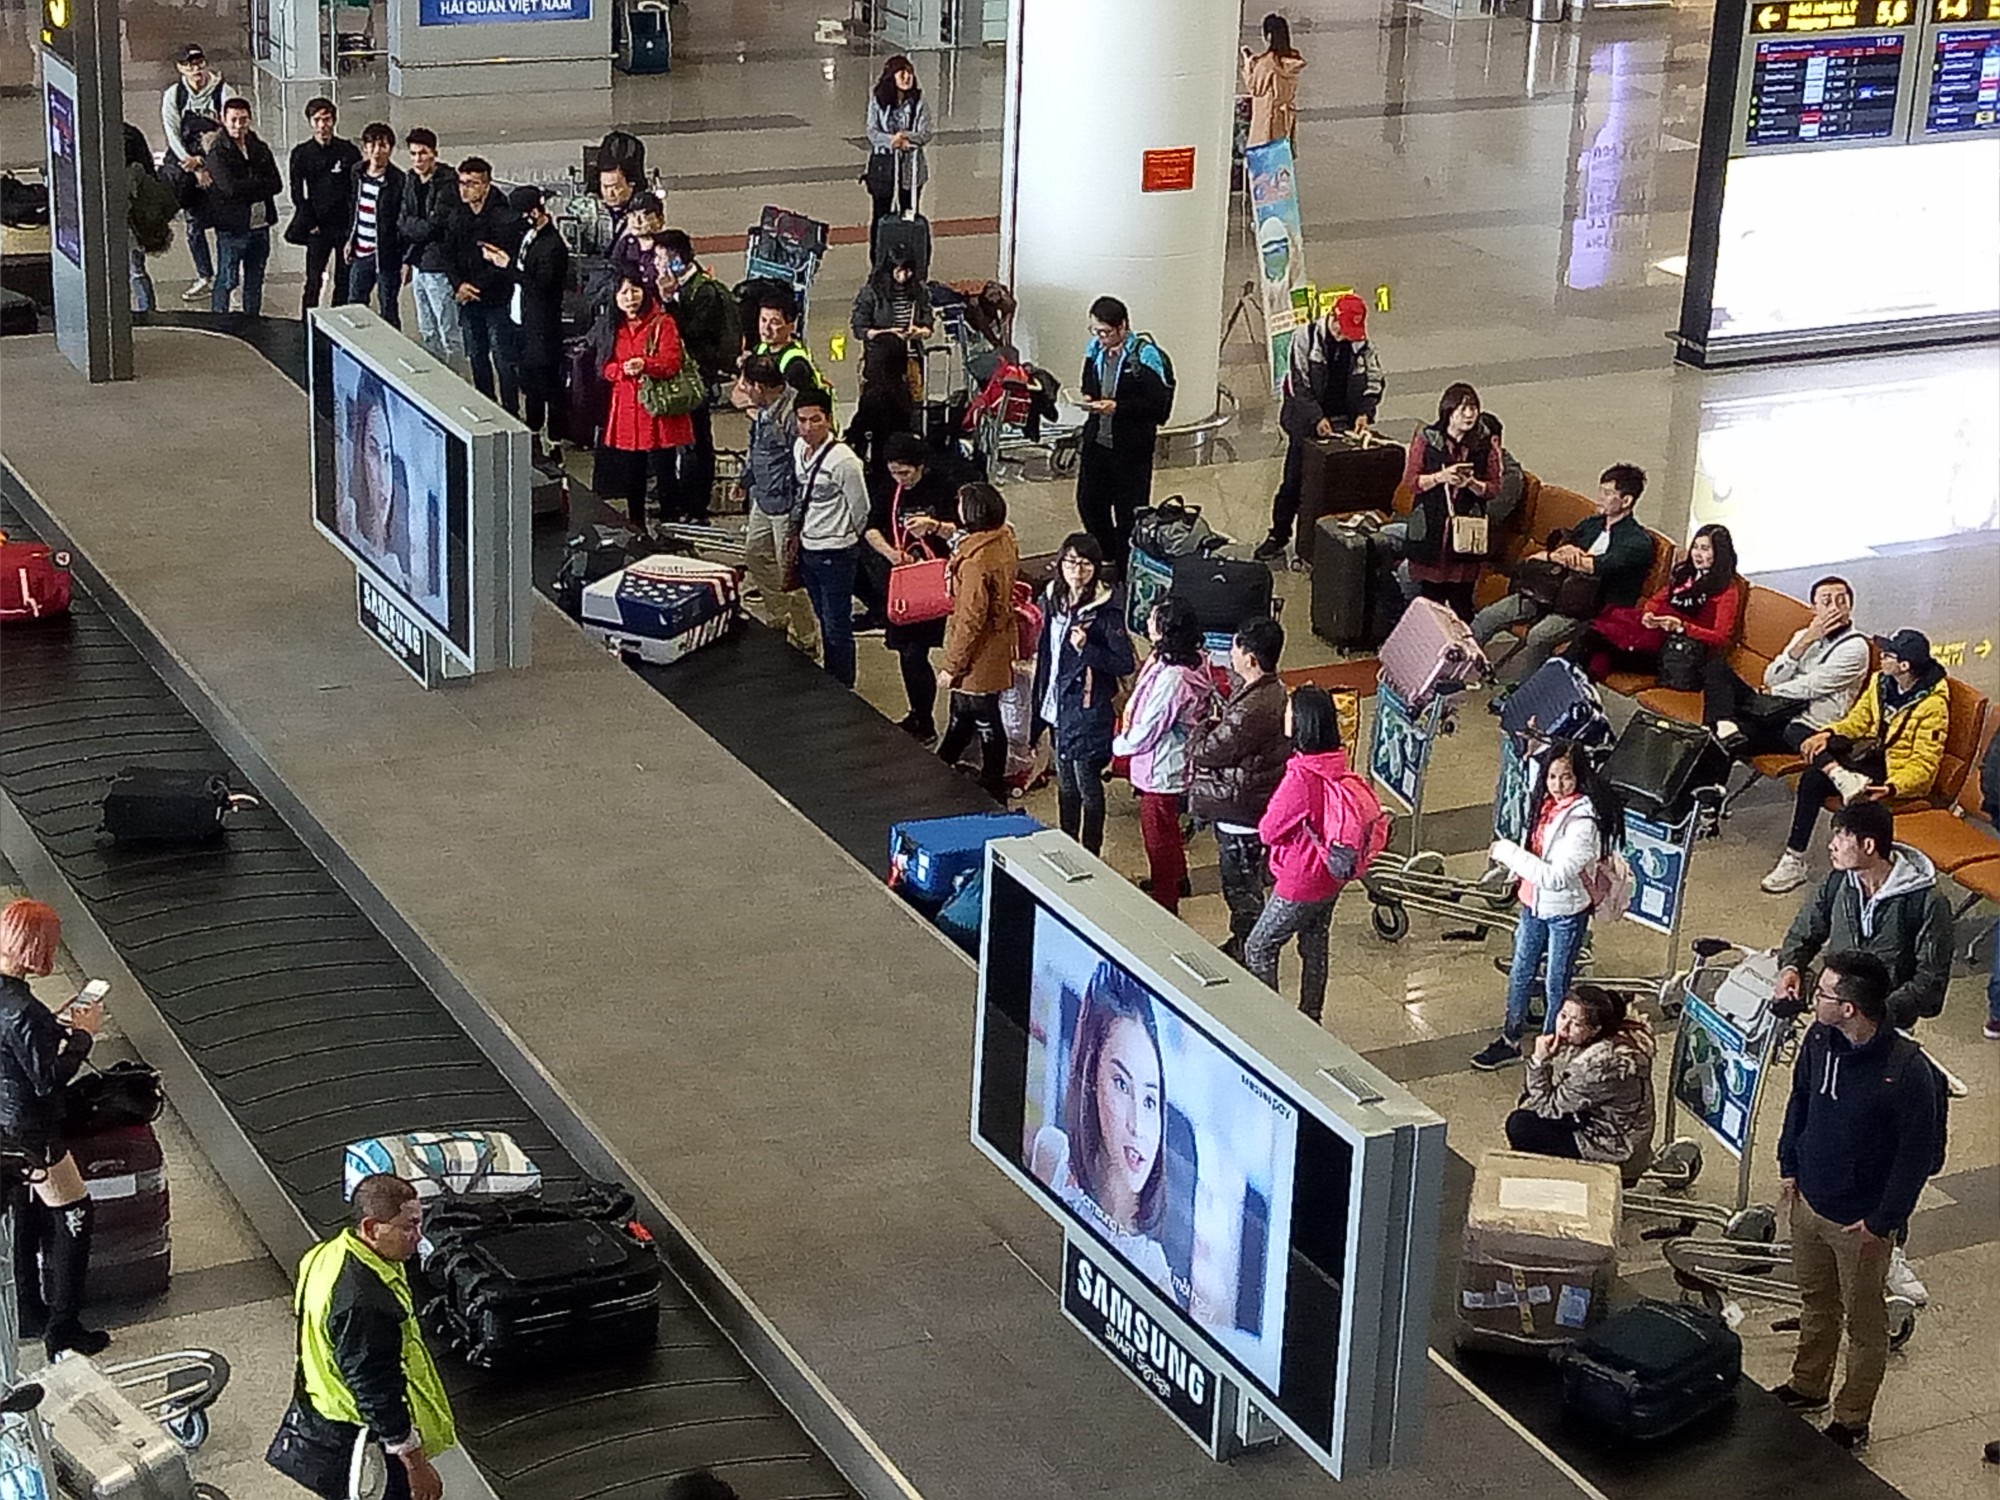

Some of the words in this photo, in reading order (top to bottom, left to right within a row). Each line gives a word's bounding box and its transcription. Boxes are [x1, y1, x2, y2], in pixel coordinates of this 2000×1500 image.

[466, 0, 506, 14] QUAN
[362, 581, 421, 656] SAMSUNG
[1076, 1258, 1206, 1406] SAMSUNG
[1104, 1322, 1136, 1364] SMART
